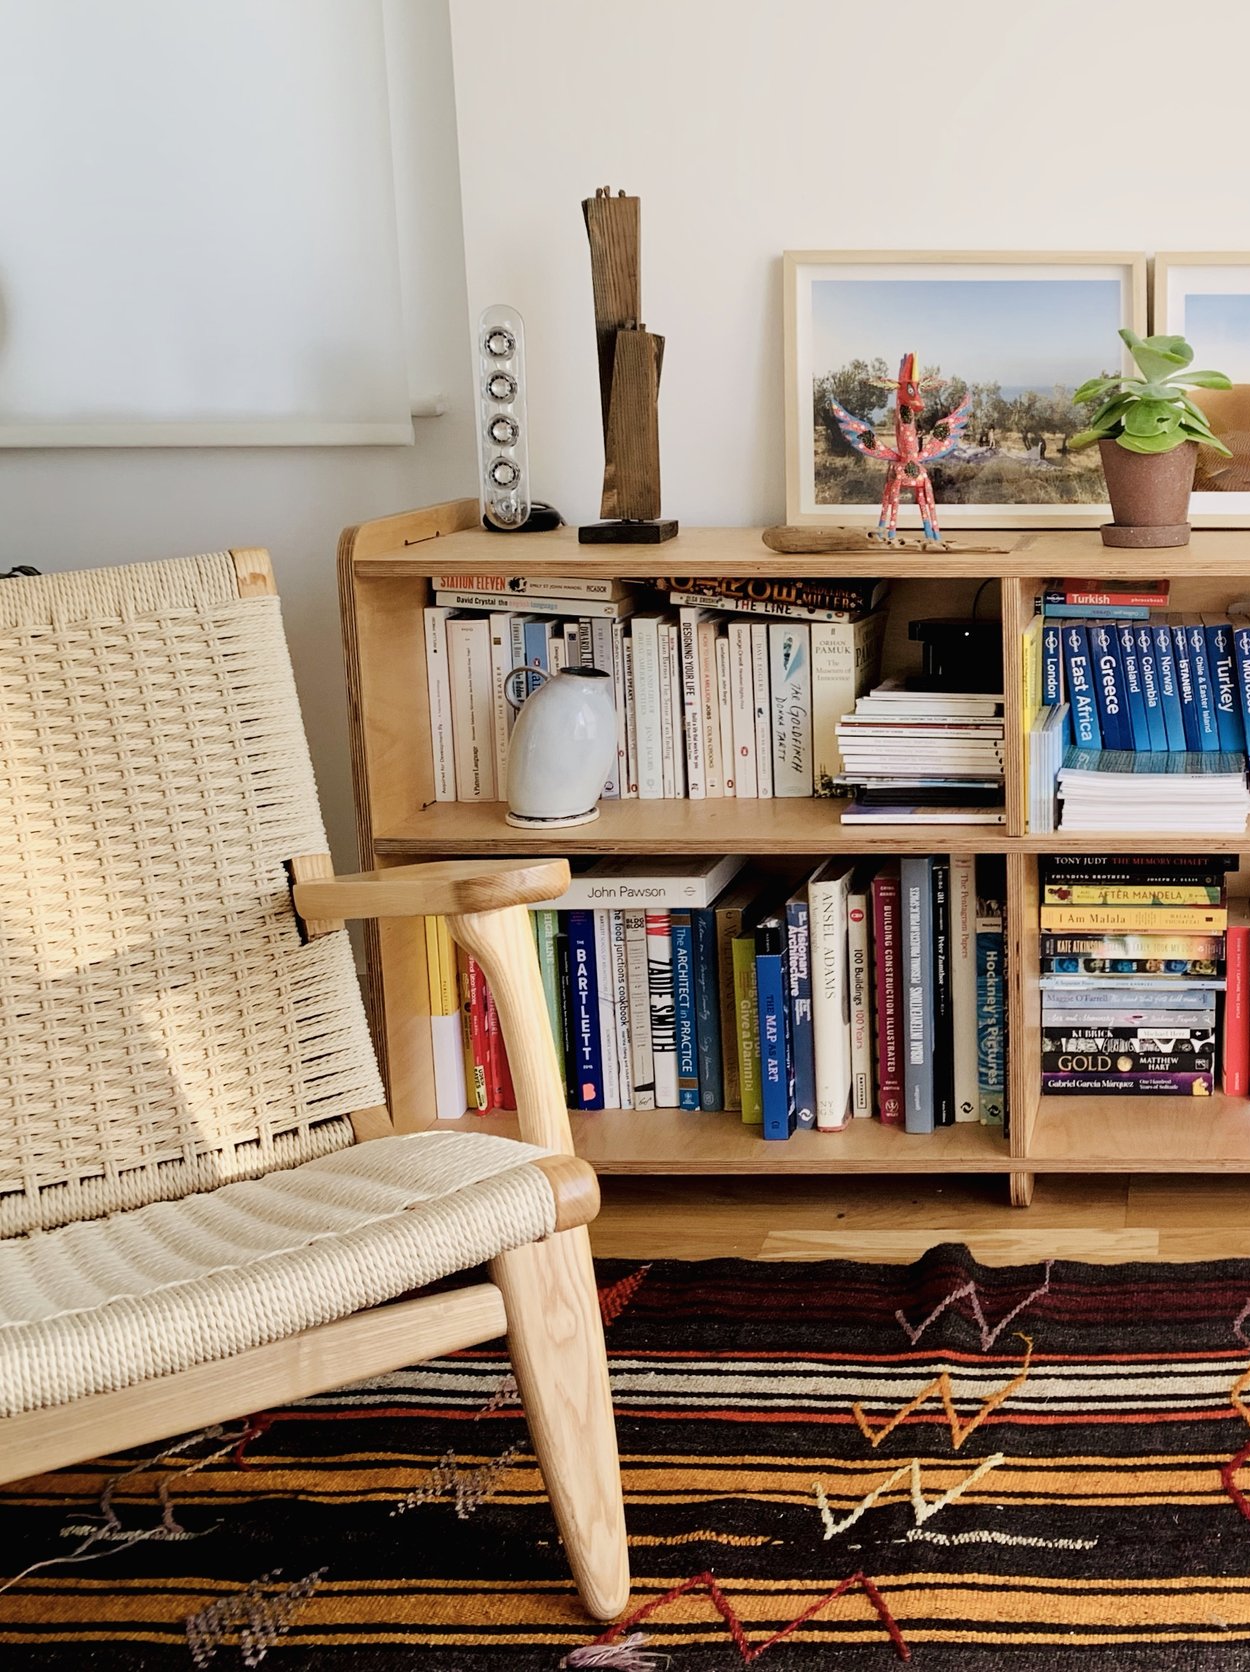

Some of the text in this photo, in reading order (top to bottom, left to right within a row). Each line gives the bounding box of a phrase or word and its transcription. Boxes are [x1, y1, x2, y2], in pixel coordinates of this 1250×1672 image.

[440, 576, 505, 591] STATION ELEVEN
[457, 596, 473, 604] David
[474, 598, 496, 606] Crystal
[1072, 594, 1110, 604] Turkish
[734, 599, 792, 615] THE LINE
[682, 622, 695, 696] DESIGNING YOUR LIFE
[1047, 658, 1058, 698] London
[1126, 656, 1140, 693] Iceland
[1161, 656, 1174, 696] Norway
[1195, 656, 1205, 675] Chile
[1070, 656, 1093, 741] East Africa
[1100, 656, 1119, 714] Greece
[1142, 656, 1157, 707] Colombia
[1199, 685, 1208, 708] Easter
[1216, 656, 1234, 712] Turkey
[775, 697, 787, 762] DONNA TARTT
[789, 683, 807, 773] The GOLDFINCH
[1202, 710, 1212, 733] Island
[1055, 857, 1108, 865] TONY JUDT
[587, 886, 666, 898] John Pawson
[614, 909, 622, 920] he
[615, 923, 624, 942] food
[645, 914, 672, 937] NW
[884, 905, 894, 947] BUILDING
[960, 874, 970, 959] The Pentagram Papers
[1066, 915, 1085, 923] Am
[1089, 914, 1126, 924] Malala
[614, 944, 627, 984] junctions
[788, 926, 800, 997] Architecture
[796, 925, 808, 980] Visionary
[823, 892, 837, 1000] ANSEL ADAMS
[676, 929, 693, 1072] The ARCHITECT in PRACTICE
[853, 948, 865, 1049] 100 Buildings 100 Years
[885, 949, 895, 1015] CONSTRUCTION
[577, 949, 591, 1060] BARTLETT
[618, 986, 628, 1026] cookbook
[647, 958, 677, 1052] ZADIE SMITH
[984, 951, 1001, 1085] Hockney's Pictures
[740, 1000, 754, 1079] Give a Damn
[766, 1015, 777, 1042] MAP
[886, 1017, 896, 1072] ILLUSTRATED
[767, 1058, 779, 1082] ART
[1058, 1056, 1111, 1071] GOLD
